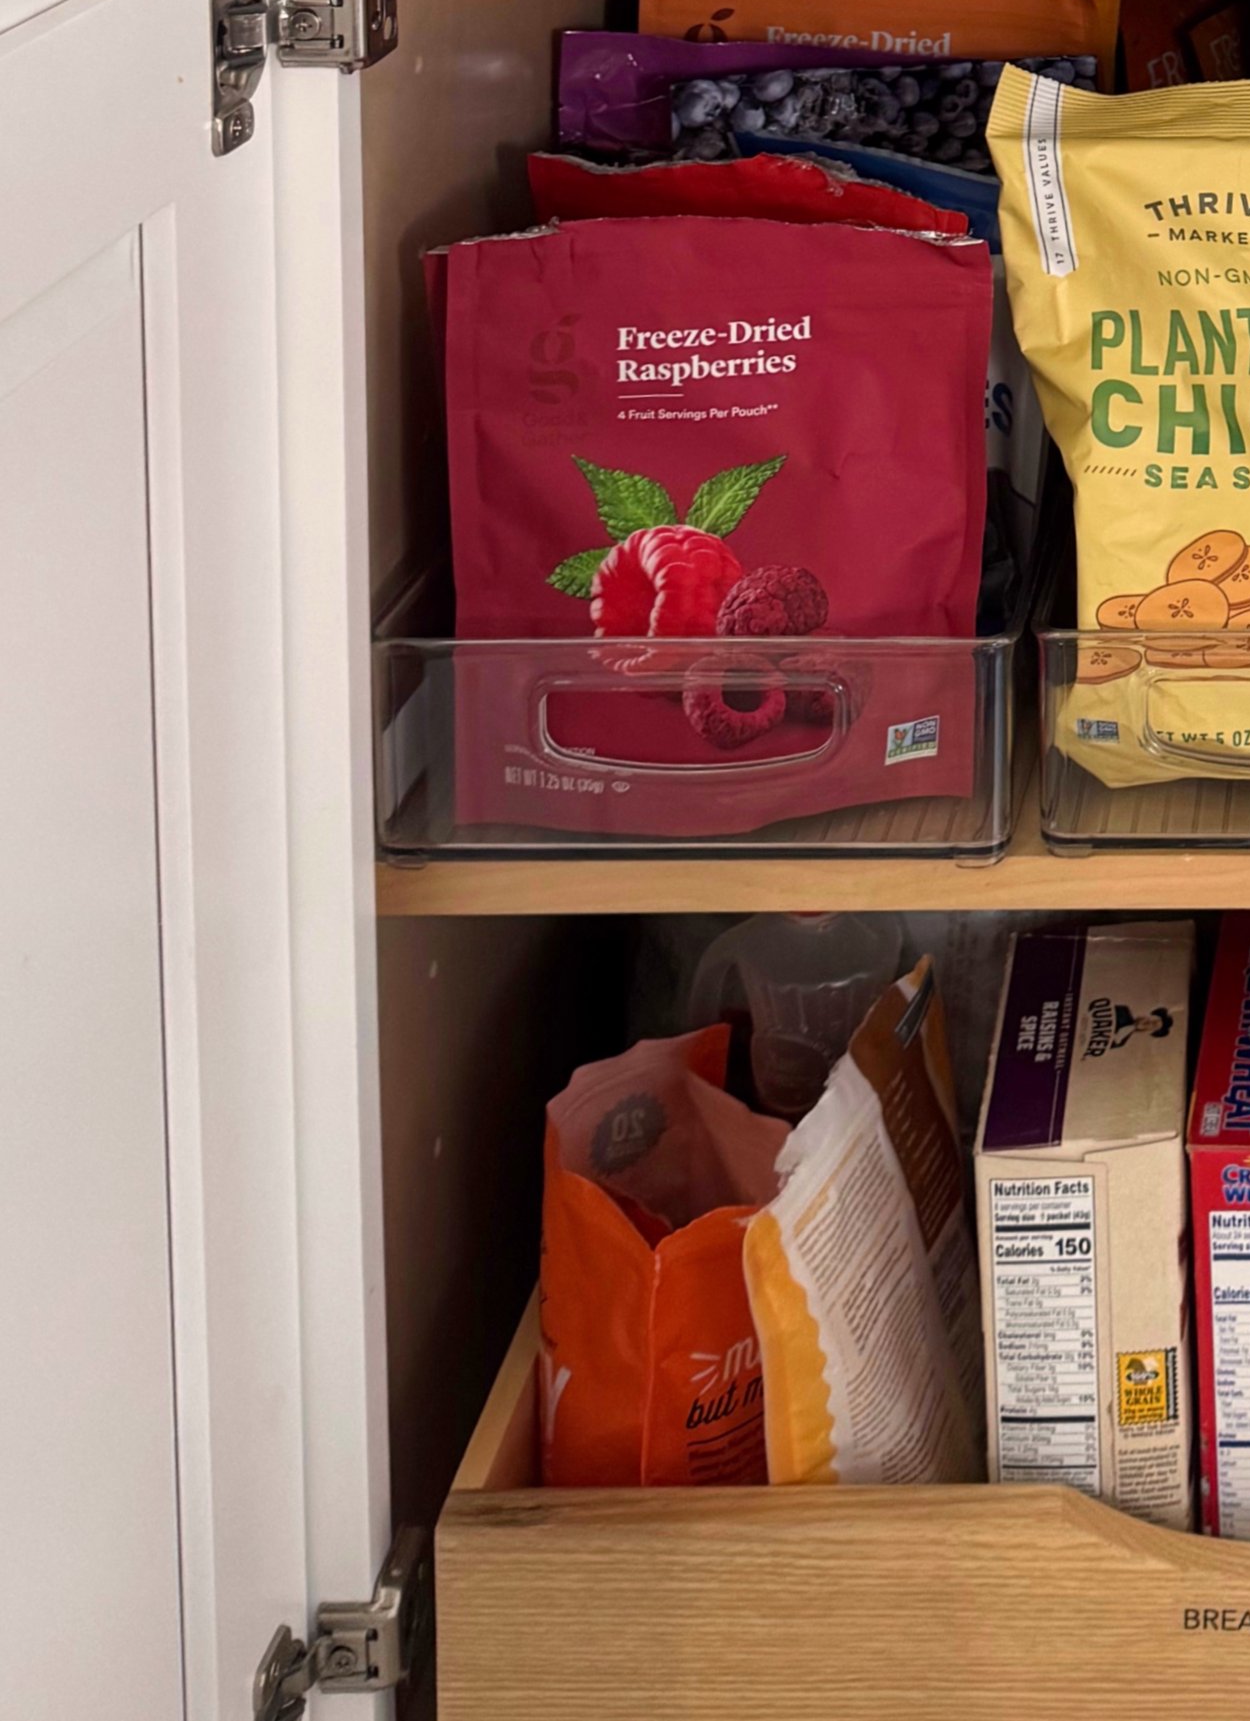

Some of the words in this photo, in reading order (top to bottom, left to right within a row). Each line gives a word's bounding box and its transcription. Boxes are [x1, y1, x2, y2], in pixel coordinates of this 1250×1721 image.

[1038, 138, 1054, 187] VALUES
[1045, 192, 1058, 243] THRIVE
[1056, 251, 1064, 264] 17
[616, 316, 812, 351] Freeze-Dried
[616, 350, 797, 386] Raspberries
[617, 410, 626, 420] 4
[628, 409, 655, 420] Fruit
[658, 408, 707, 422] Servings
[709, 407, 729, 418] Per
[1143, 464, 1219, 490] SEA
[1084, 997, 1111, 1060] QUAKER
[994, 1181, 1051, 1196] Nutrition
[1053, 1179, 1090, 1195] Facts
[995, 1242, 1044, 1258] Calories
[1054, 1237, 1092, 1256] 150
